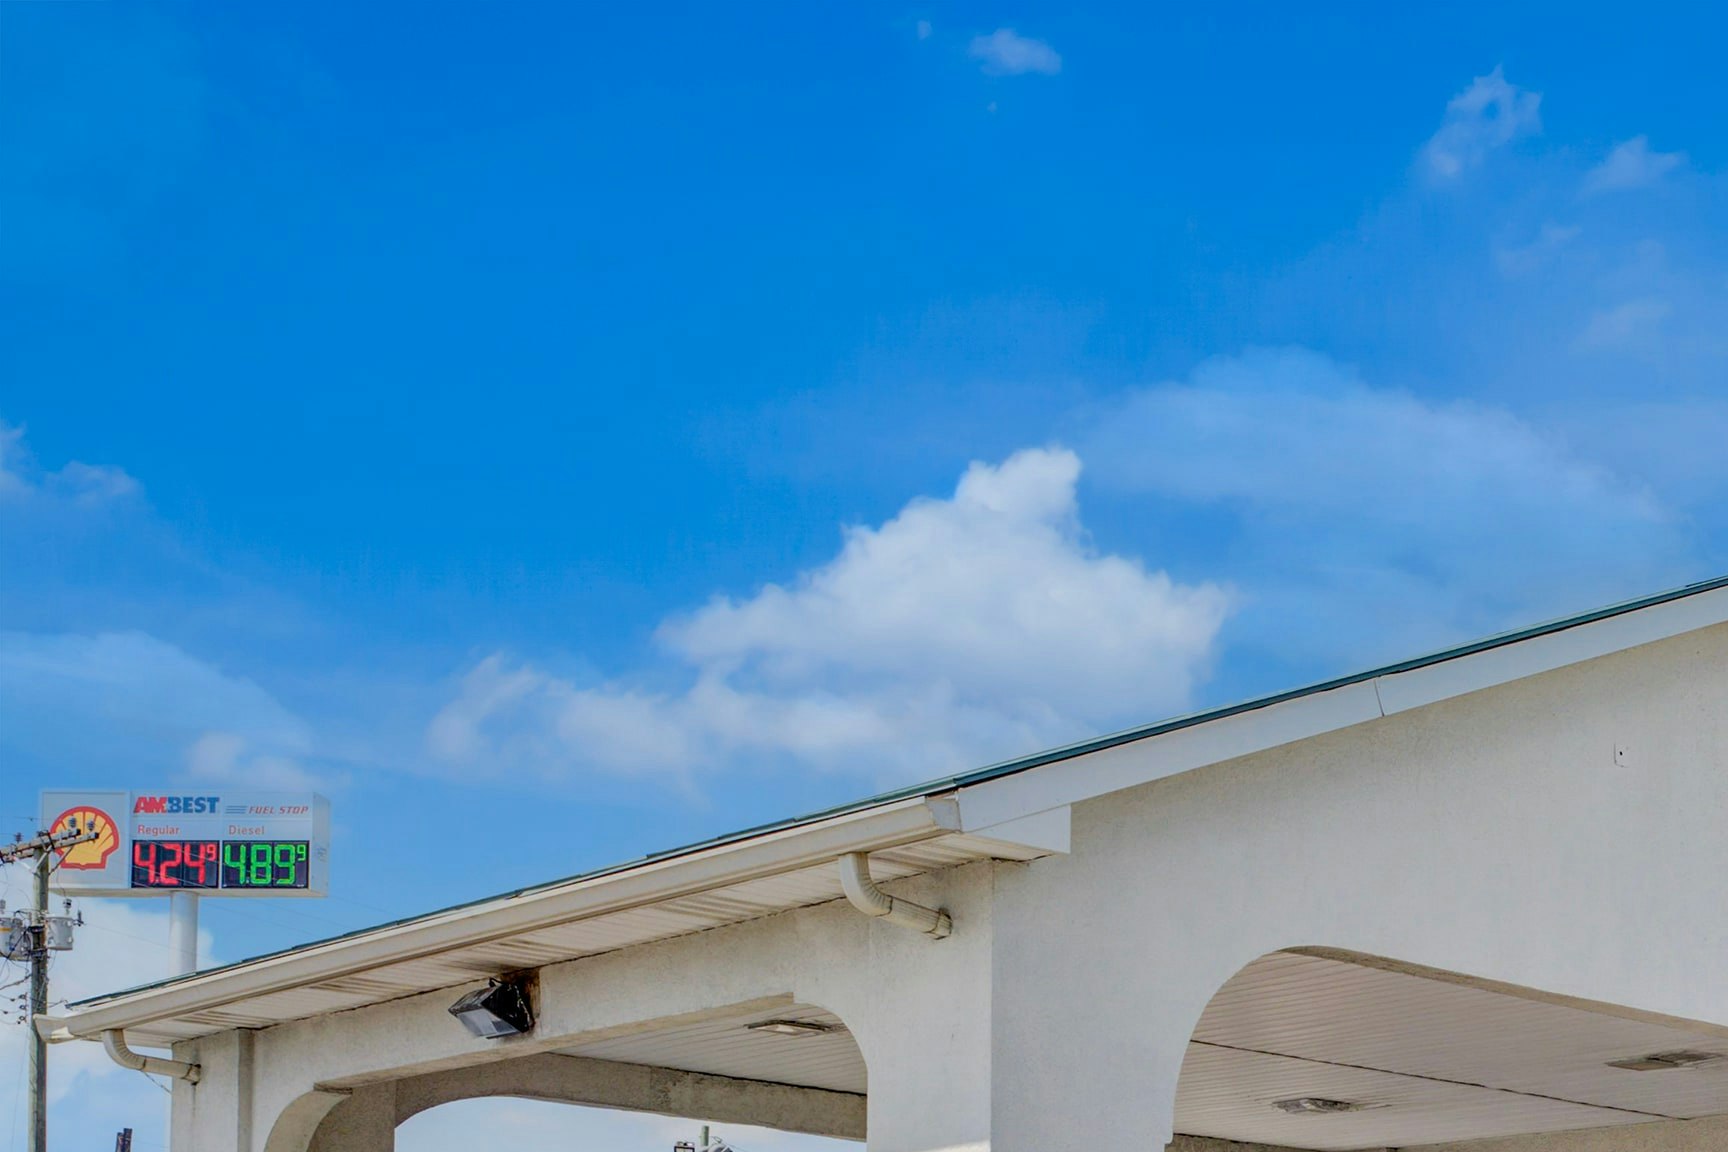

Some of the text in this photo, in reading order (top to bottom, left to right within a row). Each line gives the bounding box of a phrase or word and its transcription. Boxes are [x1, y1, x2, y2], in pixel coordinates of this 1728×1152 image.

[134, 796, 220, 814] AMBEST
[248, 806, 309, 814] FUEL STOP
[137, 824, 180, 836] Regular
[228, 824, 265, 835] Diesel
